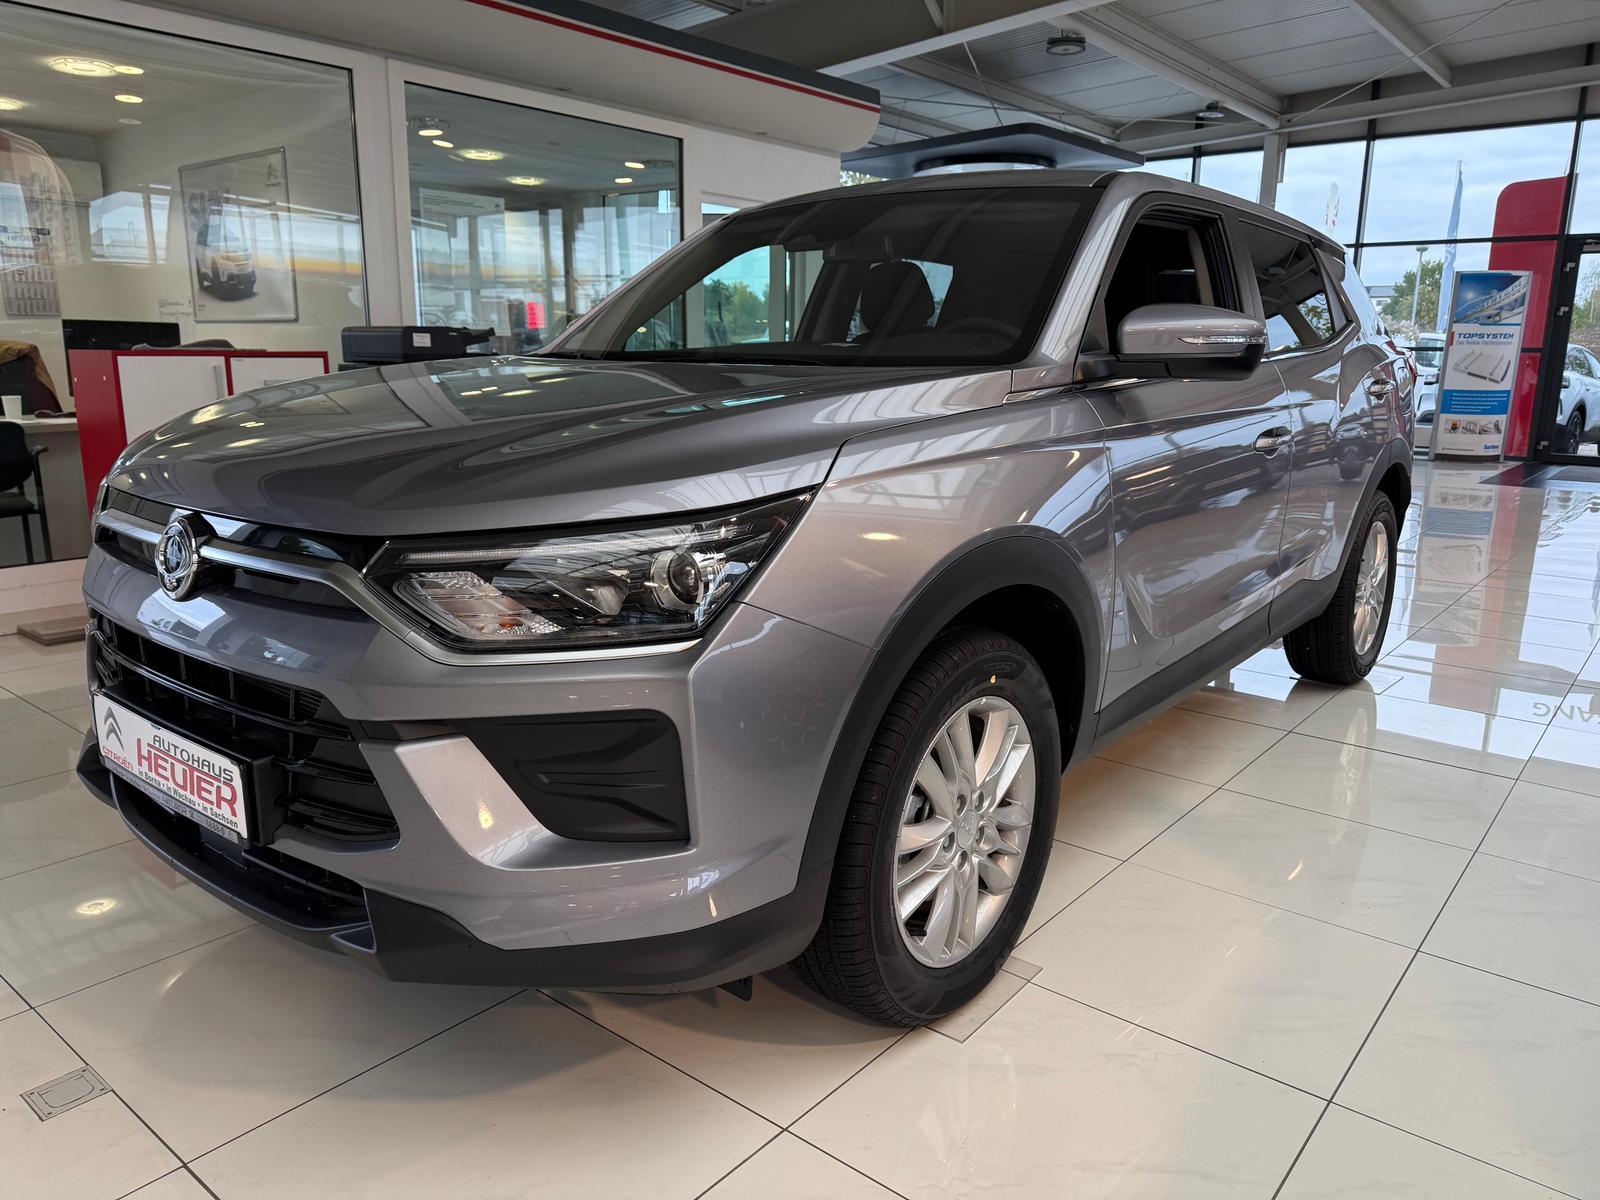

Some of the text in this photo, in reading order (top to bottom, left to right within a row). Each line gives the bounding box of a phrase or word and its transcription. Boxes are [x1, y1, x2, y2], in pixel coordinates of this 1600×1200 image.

[102, 745, 134, 771] CITROËN
[136, 737, 238, 817] HEUTER
[153, 734, 234, 783] AUTOHAUS
[138, 767, 239, 829] in Borna in Wachau in Sachsen
